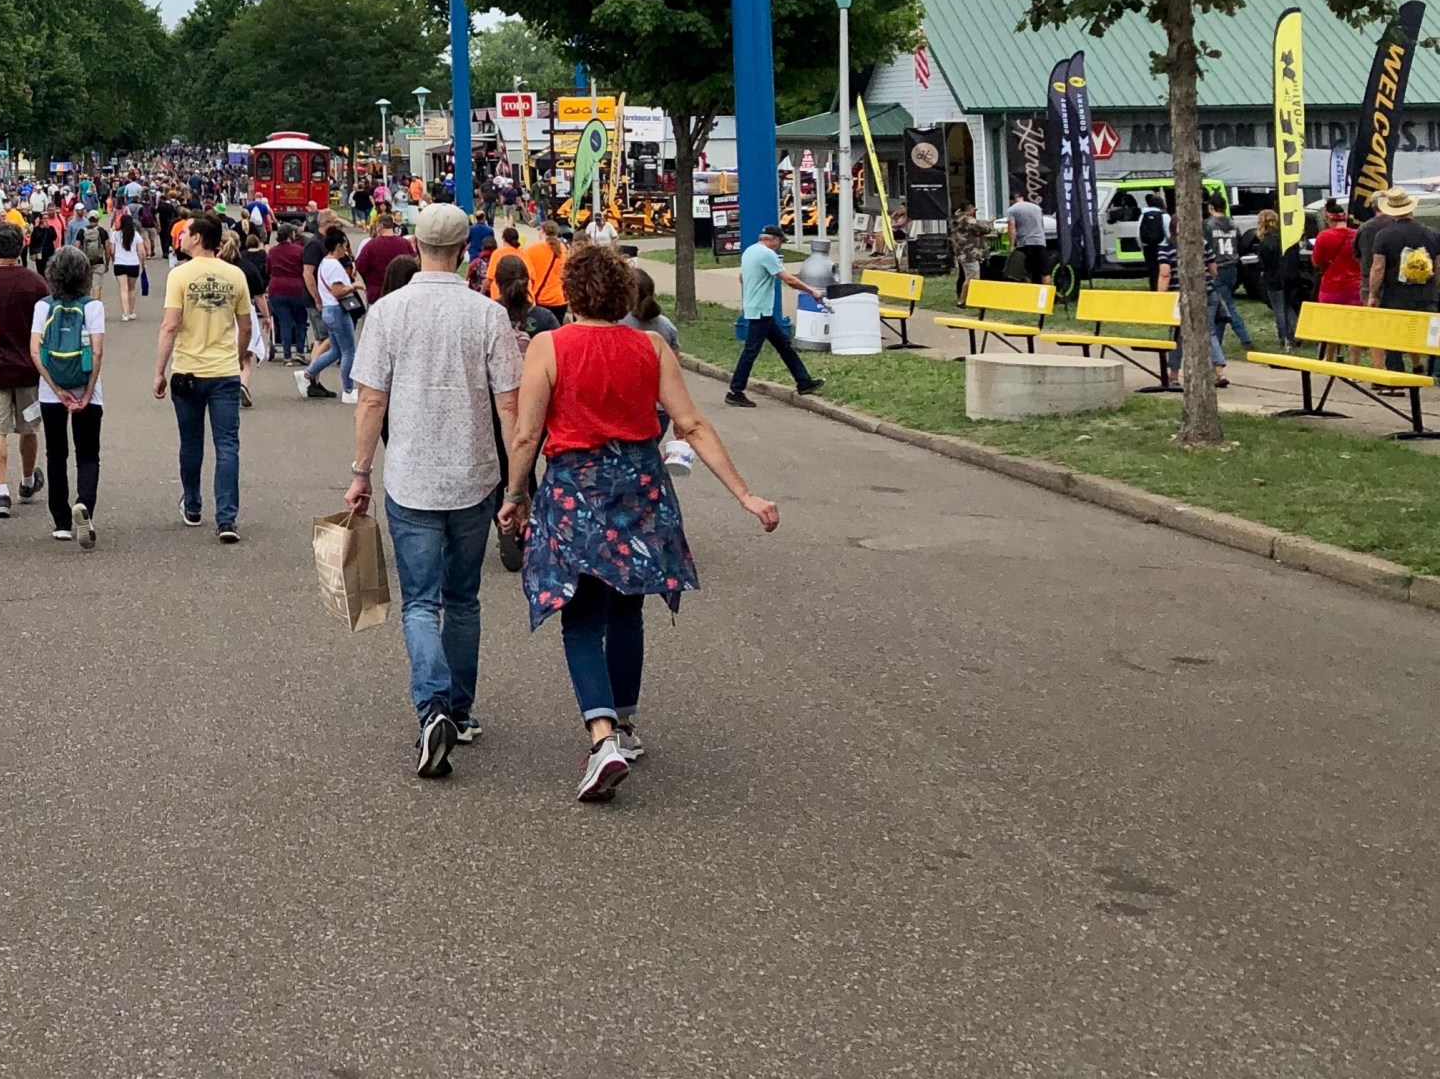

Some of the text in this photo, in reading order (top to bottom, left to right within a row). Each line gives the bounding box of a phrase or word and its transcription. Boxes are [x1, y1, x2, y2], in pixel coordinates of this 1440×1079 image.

[1076, 93, 1088, 131] COUNTRY
[1353, 43, 1405, 207] WELCOME
[1012, 119, 1048, 206] Handso
[1218, 238, 1234, 255] 14
